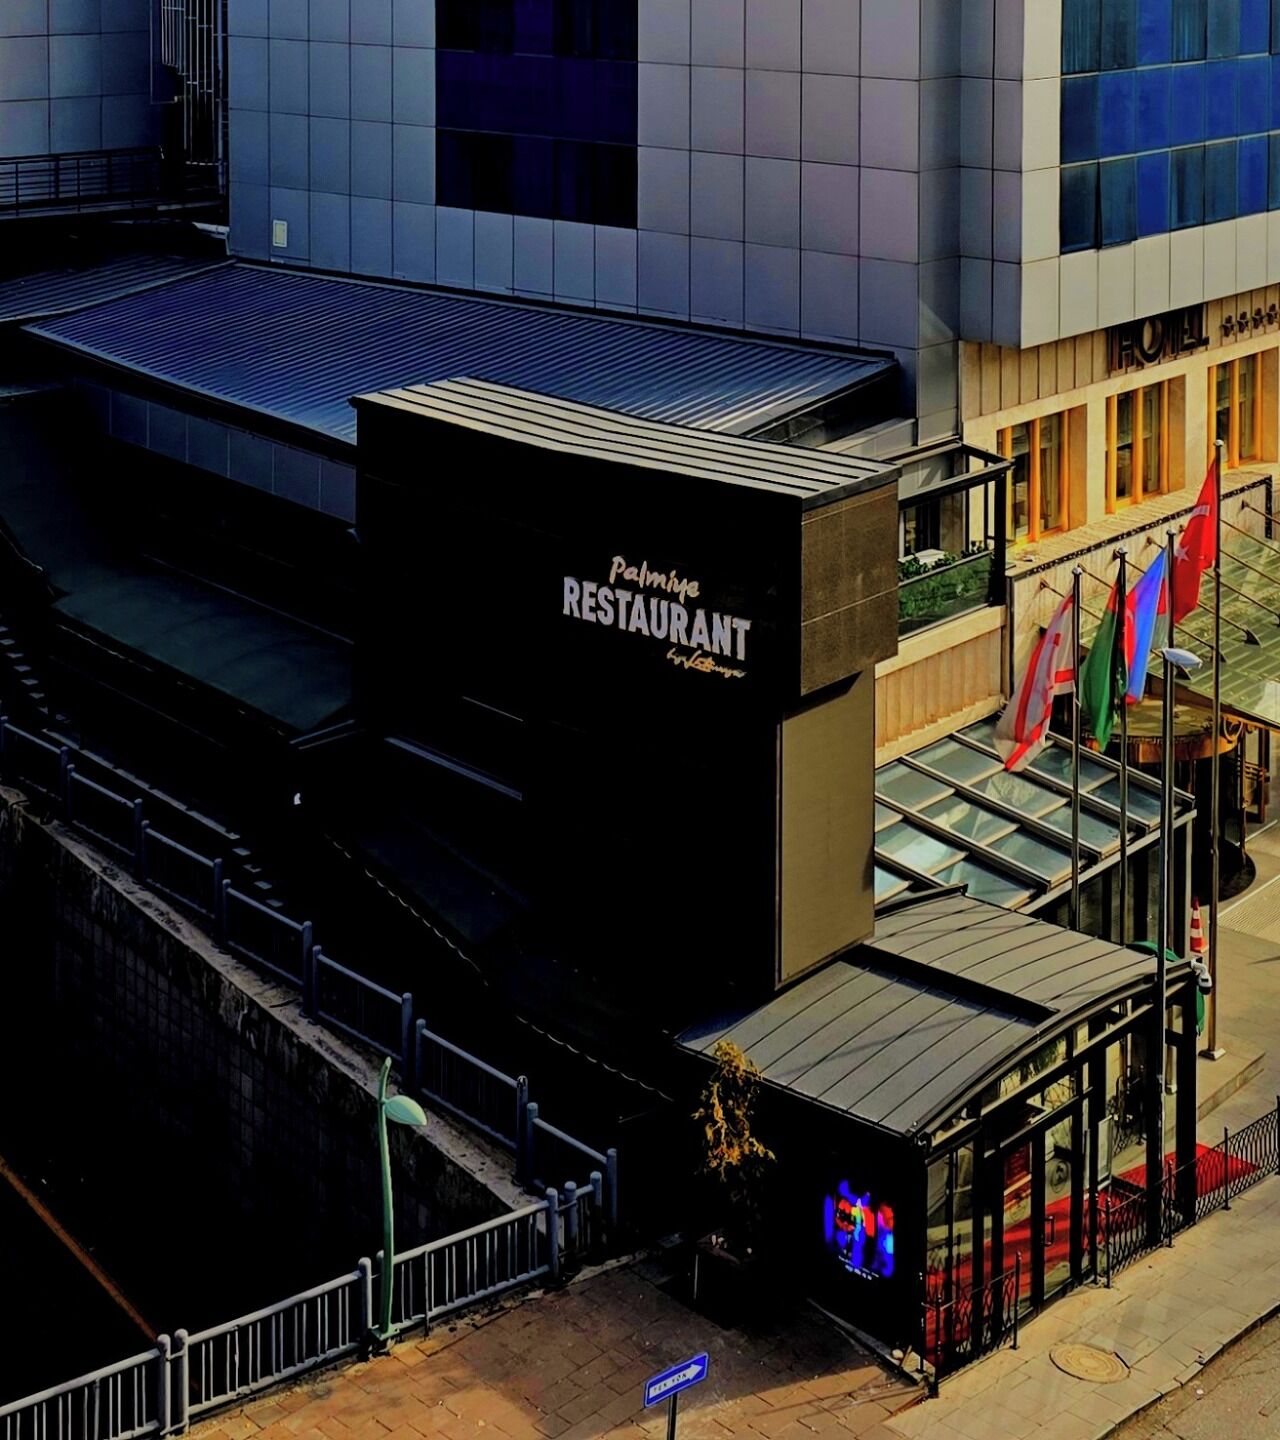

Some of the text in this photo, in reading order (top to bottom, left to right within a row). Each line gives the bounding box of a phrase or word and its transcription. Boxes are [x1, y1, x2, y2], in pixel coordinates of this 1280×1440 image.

[1106, 303, 1210, 372] HOTEL
[609, 555, 701, 605] Palmiye
[562, 576, 753, 661] RESTAURANT
